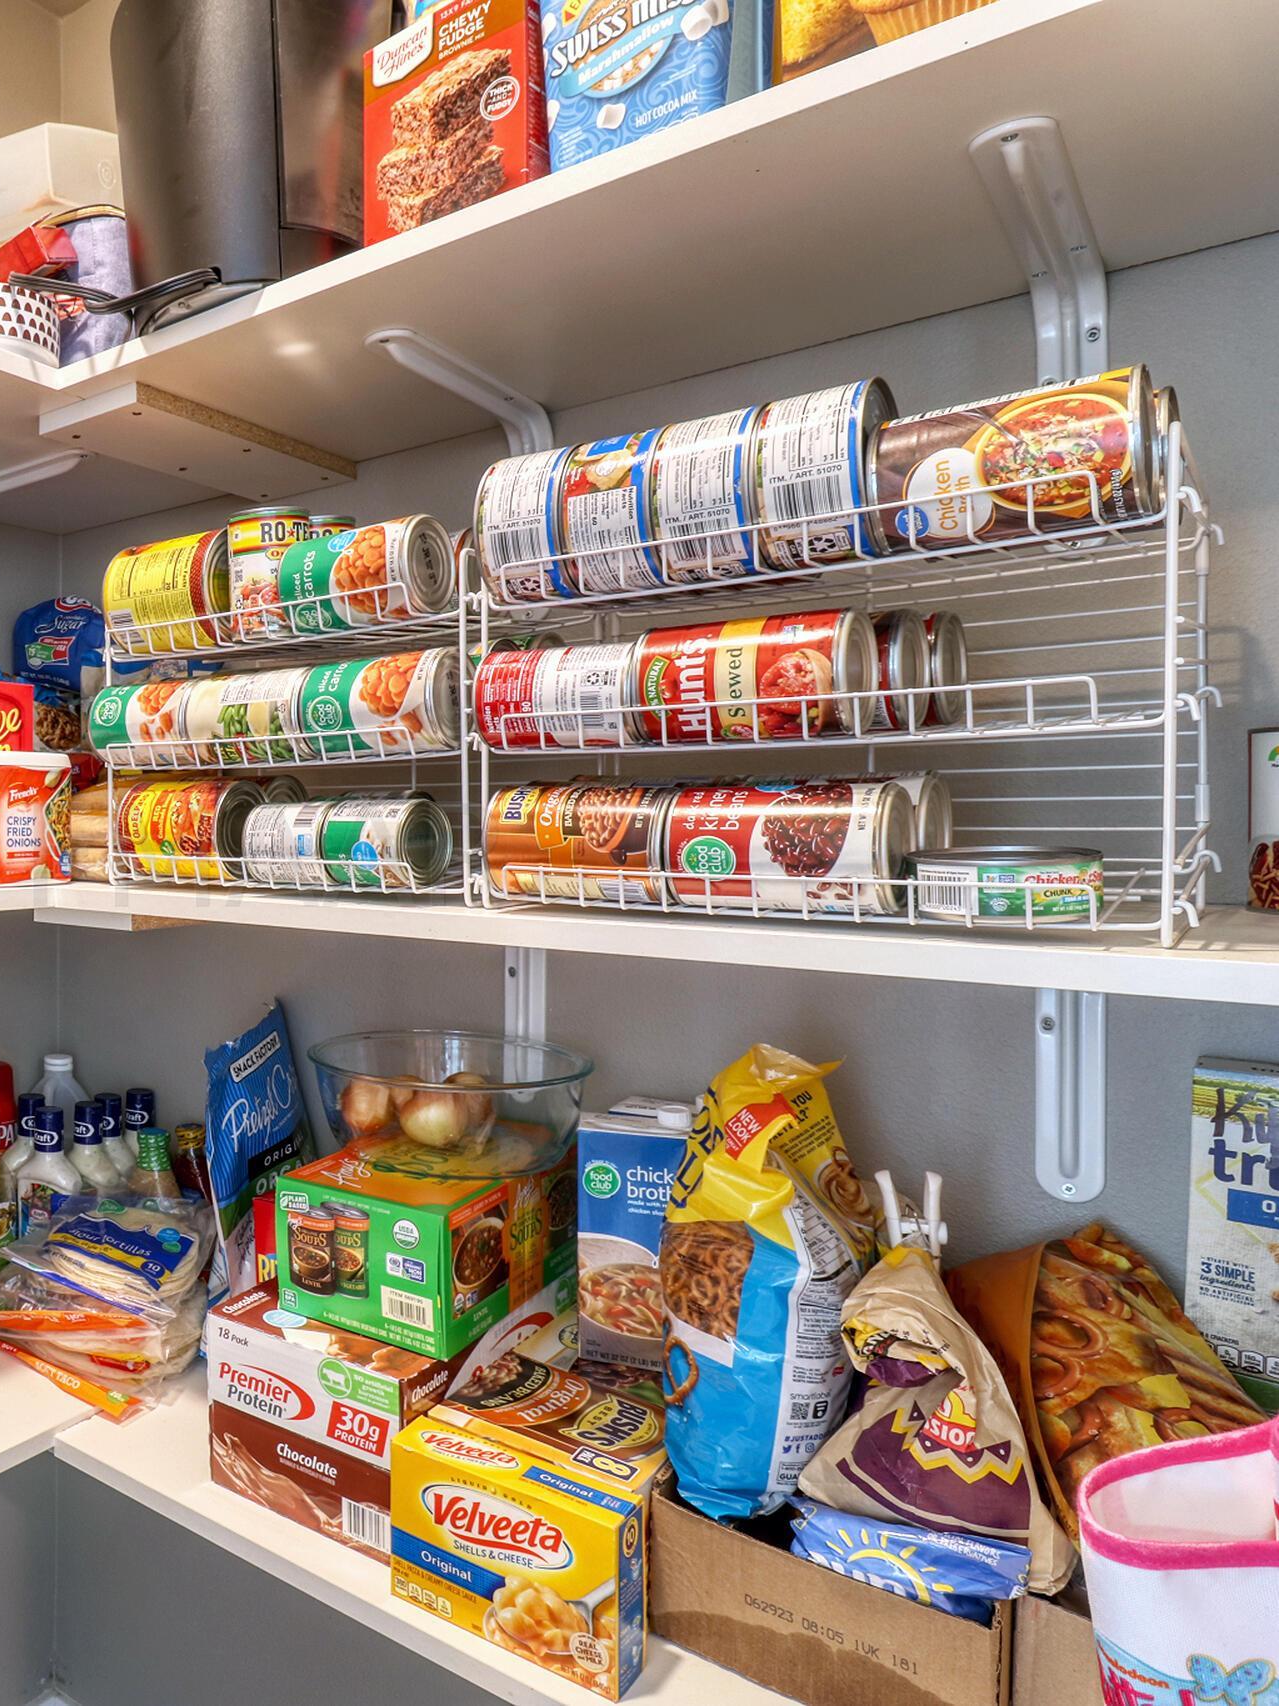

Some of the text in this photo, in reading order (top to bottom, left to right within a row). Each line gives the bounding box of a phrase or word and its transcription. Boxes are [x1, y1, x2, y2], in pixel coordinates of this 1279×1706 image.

[438, 1, 491, 37] CHEWY
[438, 17, 485, 50] FUDGE
[377, 26, 428, 70] Duncan
[438, 39, 473, 60] BROWNIE
[577, 16, 675, 85] Marshmallow
[384, 43, 424, 78] Hines
[489, 83, 514, 96] THICK
[635, 89, 698, 128] HOT COCOA MIX
[769, 464, 842, 485] ITM. ART. 51070
[522, 517, 541, 528] 51070
[708, 507, 730, 518] 51070
[303, 550, 316, 599] carrots
[35, 615, 87, 634] Sugar
[647, 660, 664, 699] NATURAL
[9, 787, 39, 802] French's
[6, 816, 37, 826] CRISPY
[6, 827, 33, 837] FRIED
[6, 838, 42, 848] ONIONS
[695, 845, 708, 875] food
[708, 846, 721, 874] club
[232, 1035, 280, 1078] SNACK FACTORY
[790, 1090, 813, 1108] YOU
[222, 1076, 276, 1153] Pretzel
[737, 1108, 762, 1134] NEW
[728, 1117, 752, 1143] LOOK
[590, 1170, 612, 1182] food
[590, 1180, 612, 1190] club
[288, 1194, 306, 1202] PLANT
[288, 1201, 307, 1210] BASED
[627, 1207, 651, 1215] chicken
[398, 1225, 414, 1235] USDA
[68, 1228, 152, 1257] flour tortillas
[146, 1262, 161, 1271] 10
[1201, 1261, 1256, 1284] 3 SIMPLE
[1200, 1273, 1256, 1292] ingredients
[1200, 1286, 1254, 1303] NO ARTIFICIAL
[218, 1326, 249, 1347] 18 Pack
[1210, 1334, 1239, 1346] CRACKERS
[586, 1350, 629, 1363] NET OZ
[35, 1360, 81, 1390] SOFT TACO
[218, 1362, 292, 1404] Premier
[365, 1380, 394, 1392] artificial
[481, 1365, 547, 1407] BAKED BEANS
[227, 1383, 284, 1419] Protein
[518, 1378, 585, 1423] Original
[336, 1406, 380, 1441] 30g
[587, 1405, 613, 1427] BEST
[334, 1429, 378, 1453] PROTEIN
[593, 1456, 631, 1476] 8
[539, 1473, 594, 1499] Original
[432, 1493, 563, 1553] Velveeta
[453, 1540, 534, 1569] SHELLS CHEESE
[421, 1550, 473, 1583] Original
[578, 1640, 597, 1651] REAL
[744, 1593, 919, 1677] 062923 08:05 181
[575, 1646, 603, 1660] CHEESE
[584, 1655, 603, 1666] MILK
